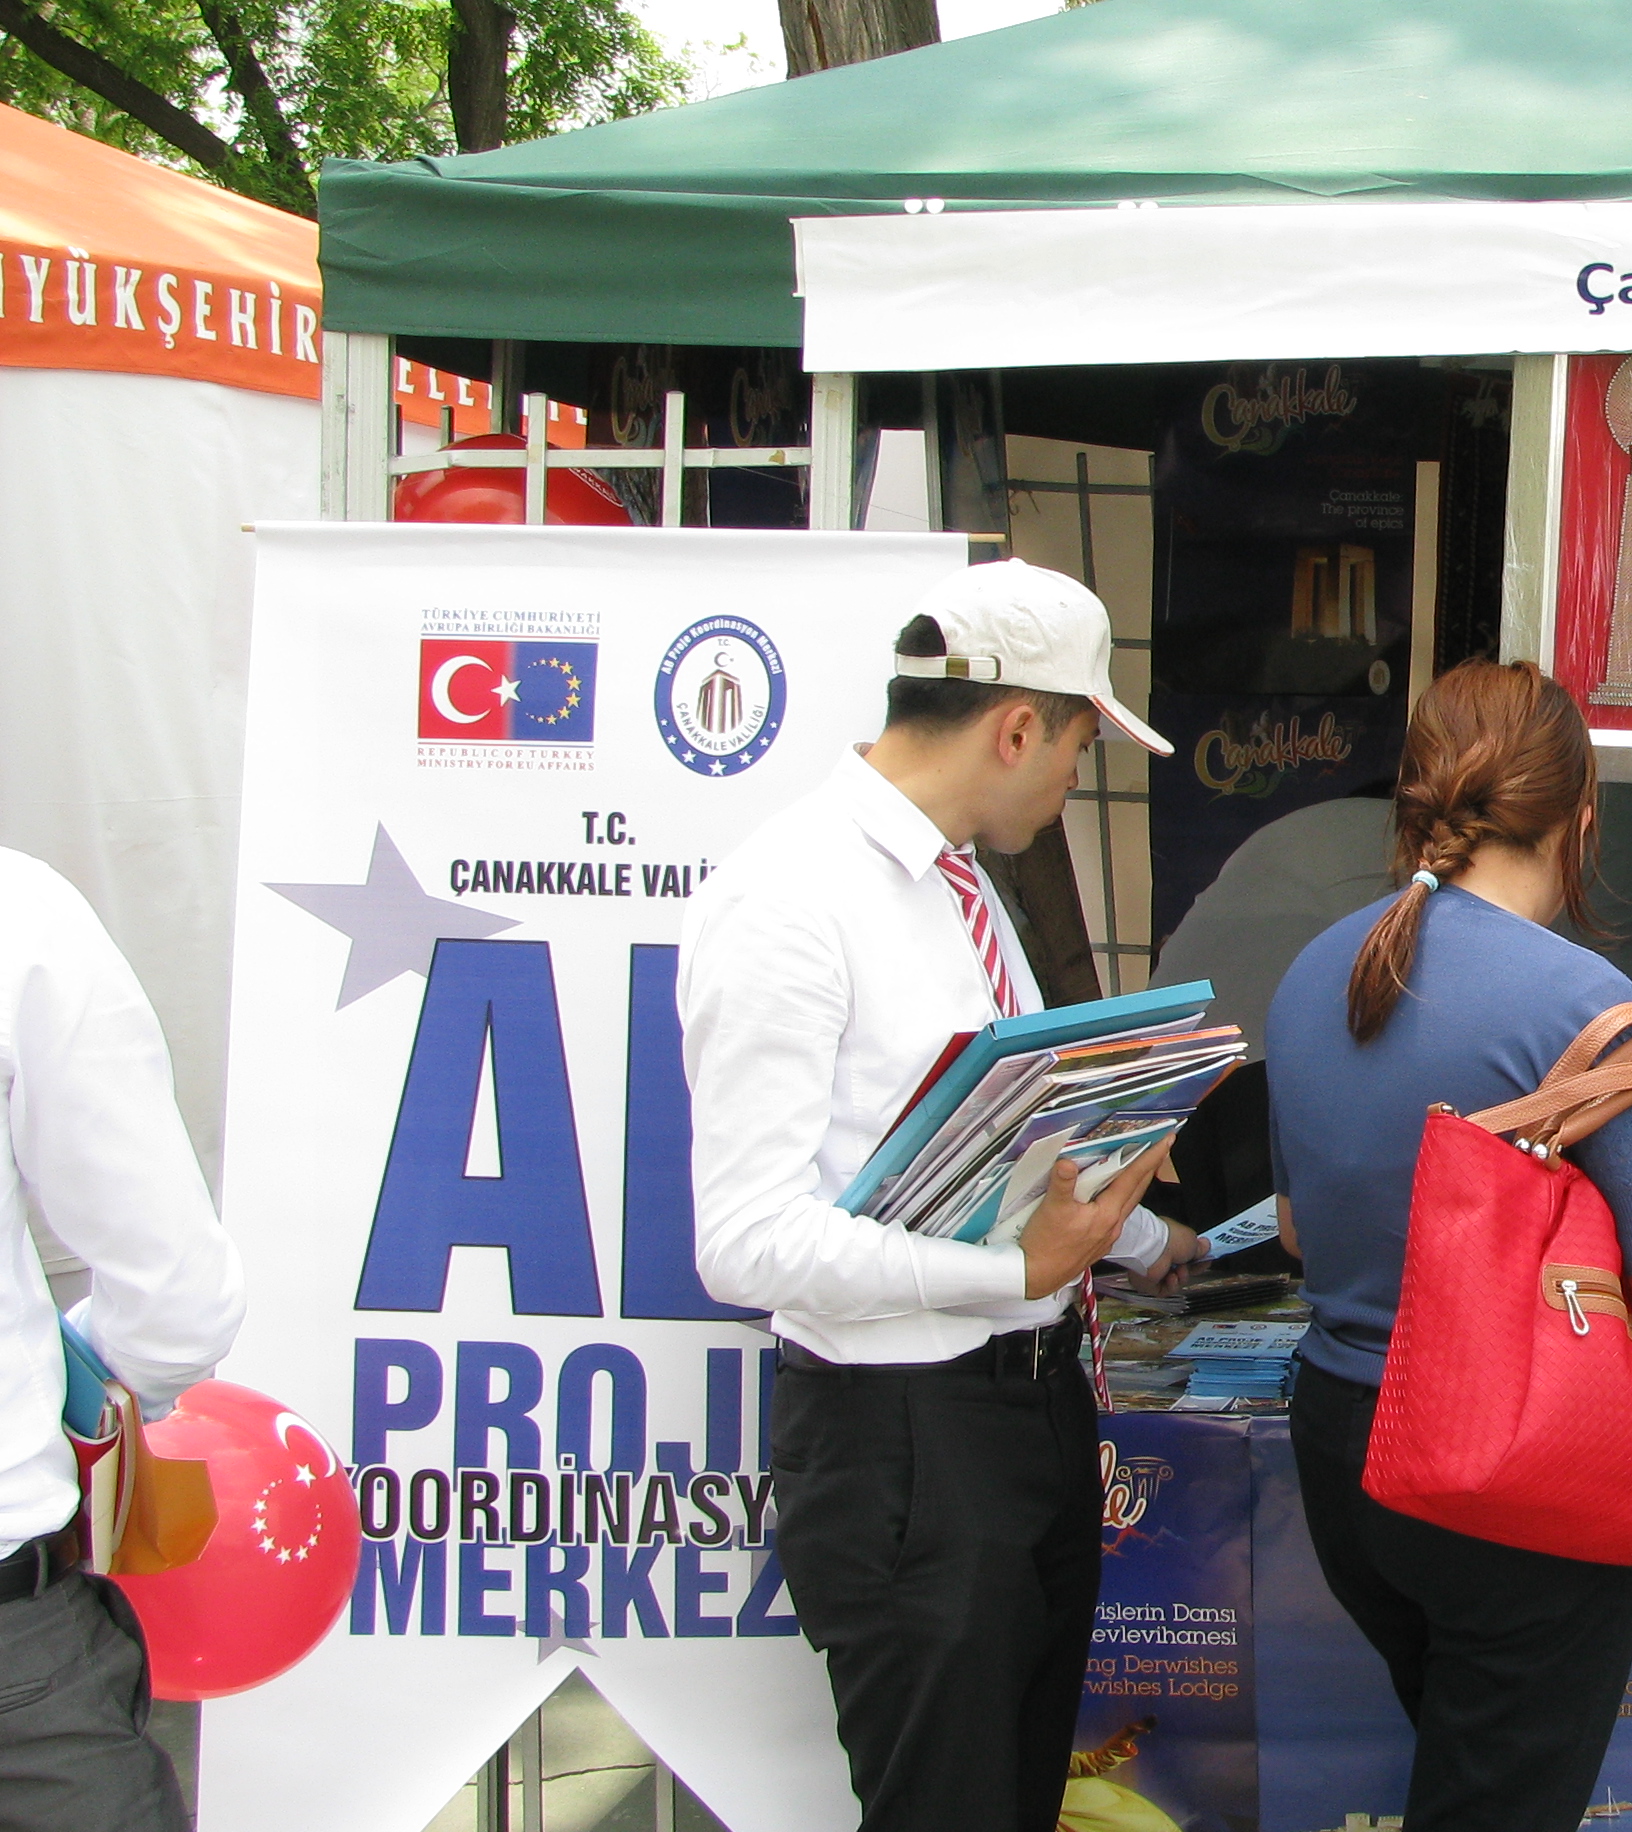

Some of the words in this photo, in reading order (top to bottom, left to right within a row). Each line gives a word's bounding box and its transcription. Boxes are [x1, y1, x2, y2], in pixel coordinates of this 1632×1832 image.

[0, 246, 320, 364] YÜKŞEHİR
[1320, 502, 1344, 515] The
[1347, 504, 1405, 518] province
[1370, 518, 1404, 532] epics
[422, 608, 489, 621] TÜRKİYE
[493, 610, 600, 623] CUMHURİYETİ
[421, 622, 470, 632] AVRUPA
[474, 622, 524, 634] BİRLİĞİ
[527, 624, 600, 635] BAKANLIĞI
[417, 748, 499, 758] REPUBLIC
[504, 750, 524, 758] OF
[530, 750, 595, 760] TURKEY
[417, 758, 484, 769] MINISTRY
[537, 761, 595, 771] AFFAIRS
[582, 812, 636, 845] T.C.
[450, 859, 632, 897] ÇANAKKALE
[1172, 1603, 1238, 1623] Dansı
[1090, 1625, 1239, 1646] evlevihanesi
[1124, 1654, 1239, 1675] Derwishes
[1168, 1678, 1239, 1701] Lodge
